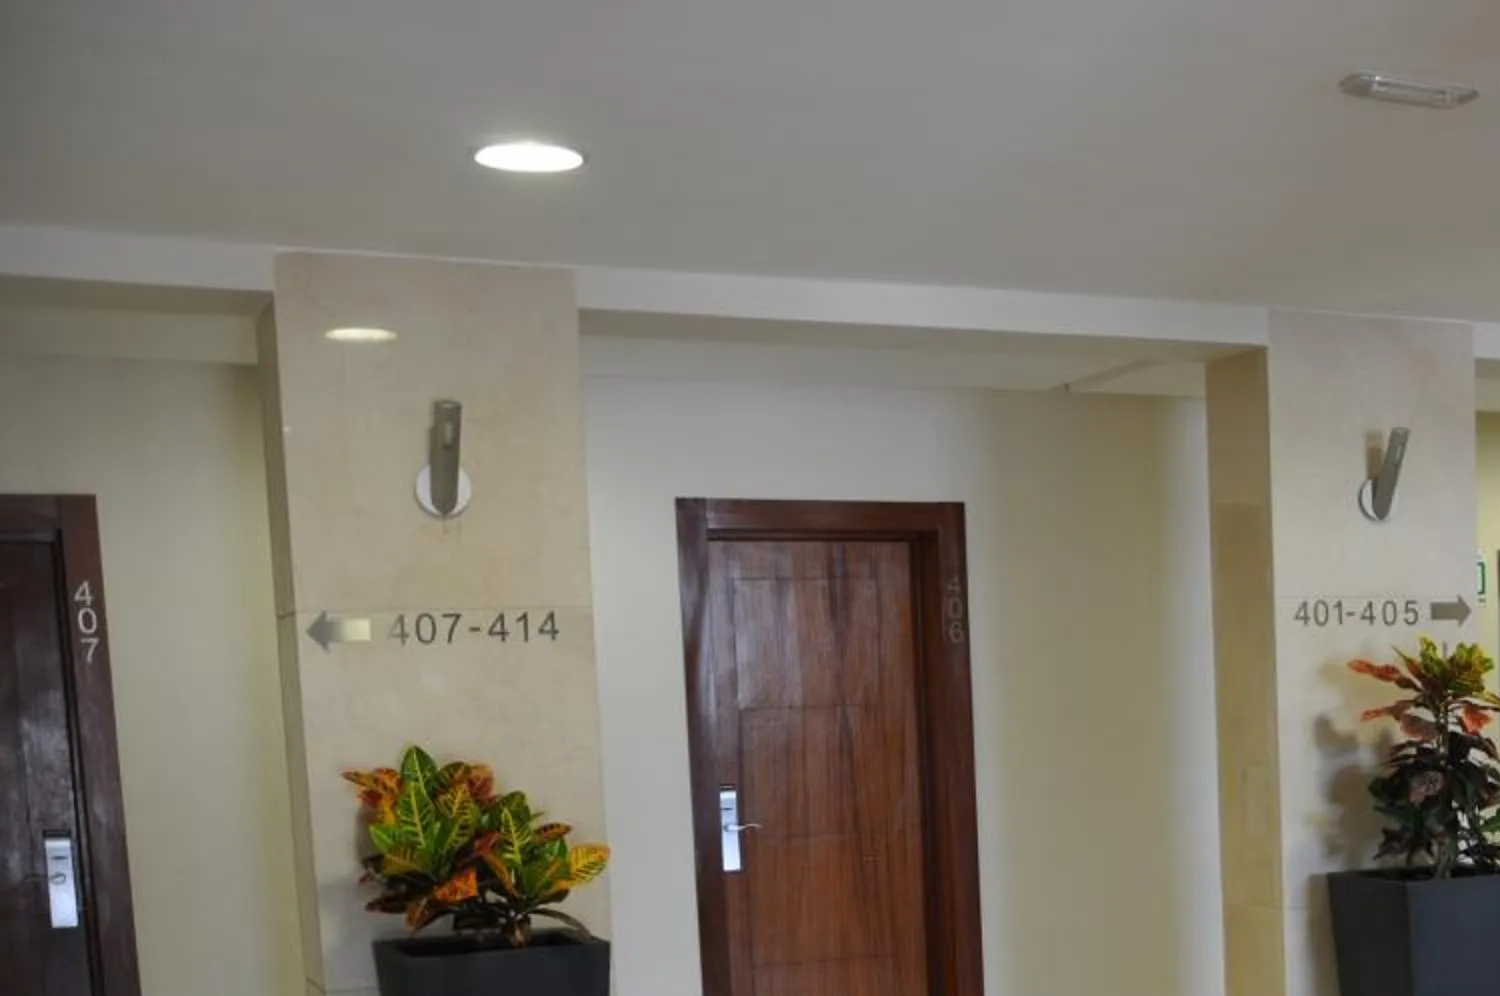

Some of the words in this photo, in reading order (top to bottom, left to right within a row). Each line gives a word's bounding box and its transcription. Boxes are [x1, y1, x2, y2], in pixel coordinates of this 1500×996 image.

[74, 581, 99, 663] 407
[388, 611, 560, 646] 407-414
[1294, 600, 1419, 627] 401-405
